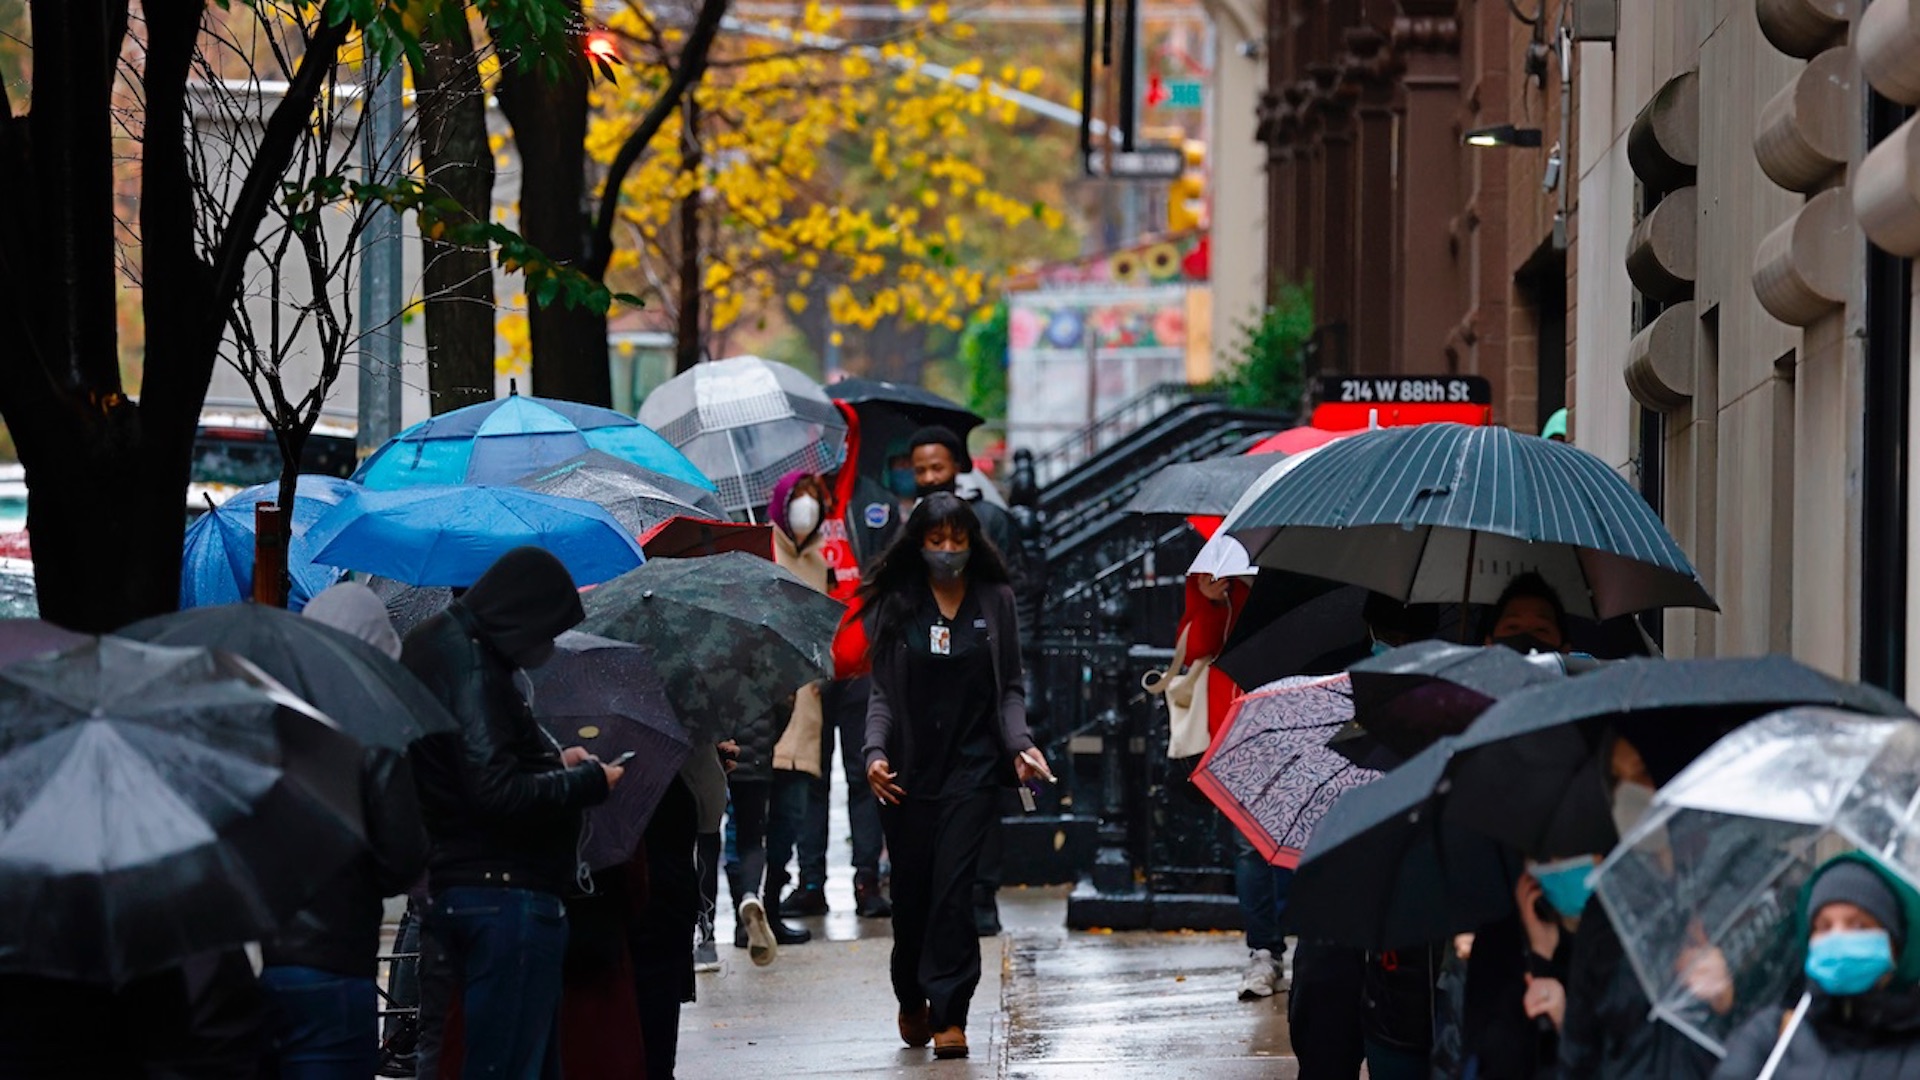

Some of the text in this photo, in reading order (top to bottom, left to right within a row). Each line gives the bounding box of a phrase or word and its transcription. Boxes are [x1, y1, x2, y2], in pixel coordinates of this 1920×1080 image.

[1341, 380, 1469, 401] 214 W 88th St
